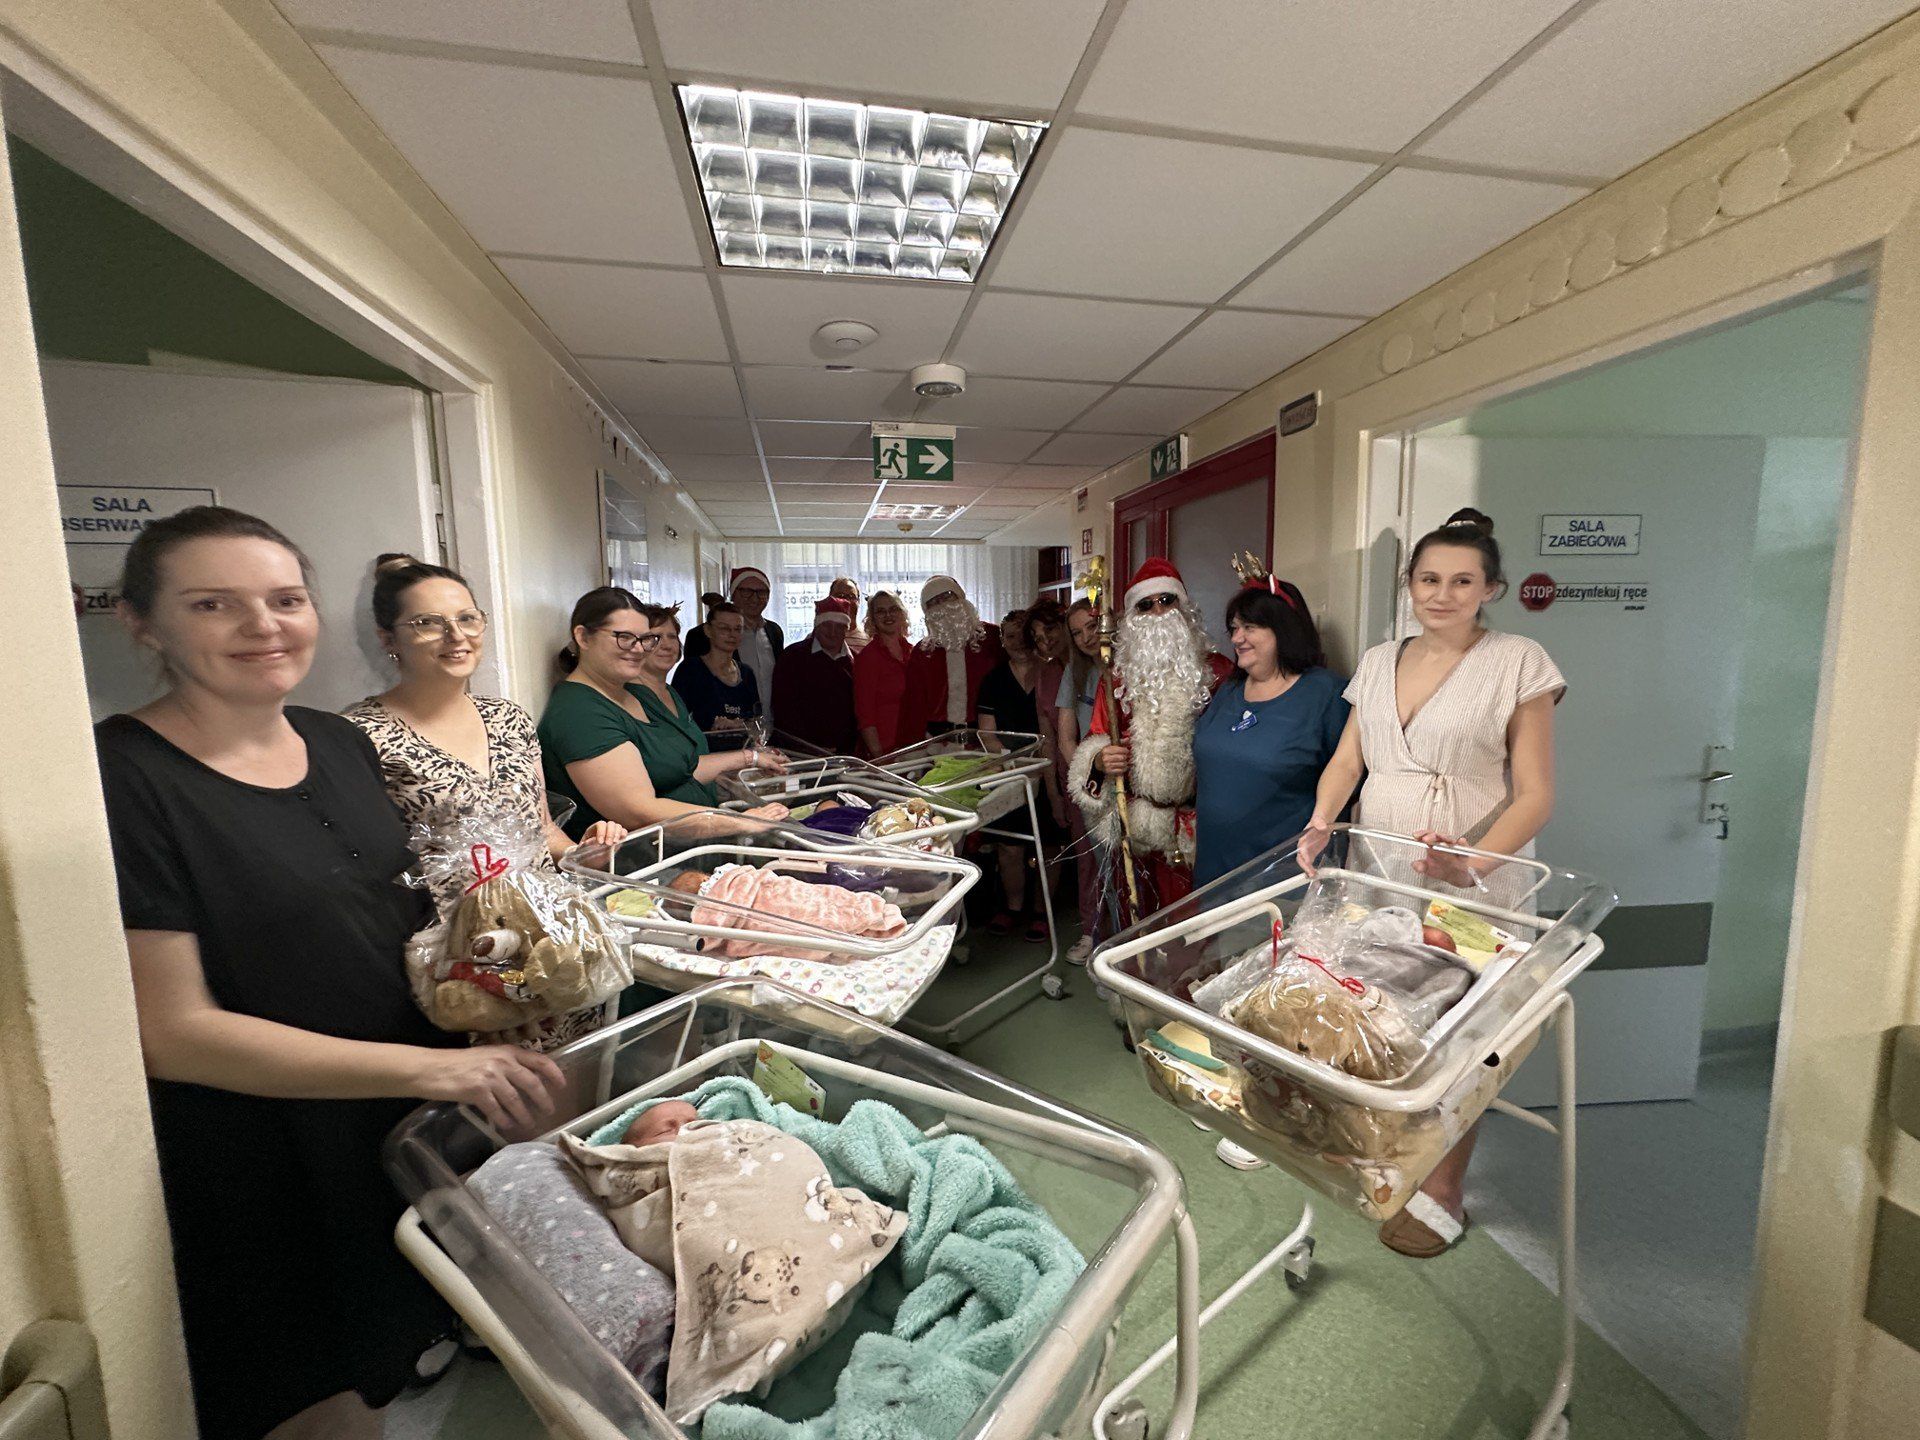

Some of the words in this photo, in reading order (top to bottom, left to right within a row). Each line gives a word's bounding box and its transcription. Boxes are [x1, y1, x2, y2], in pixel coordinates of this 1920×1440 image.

[93, 496, 153, 512] SALA
[1569, 520, 1605, 532] SALA
[1548, 535, 1626, 548] ZABIEGOWA
[1523, 585, 1553, 598] STOP
[1556, 586, 1620, 600] zdezynfekuj
[1623, 587, 1647, 599] ręce
